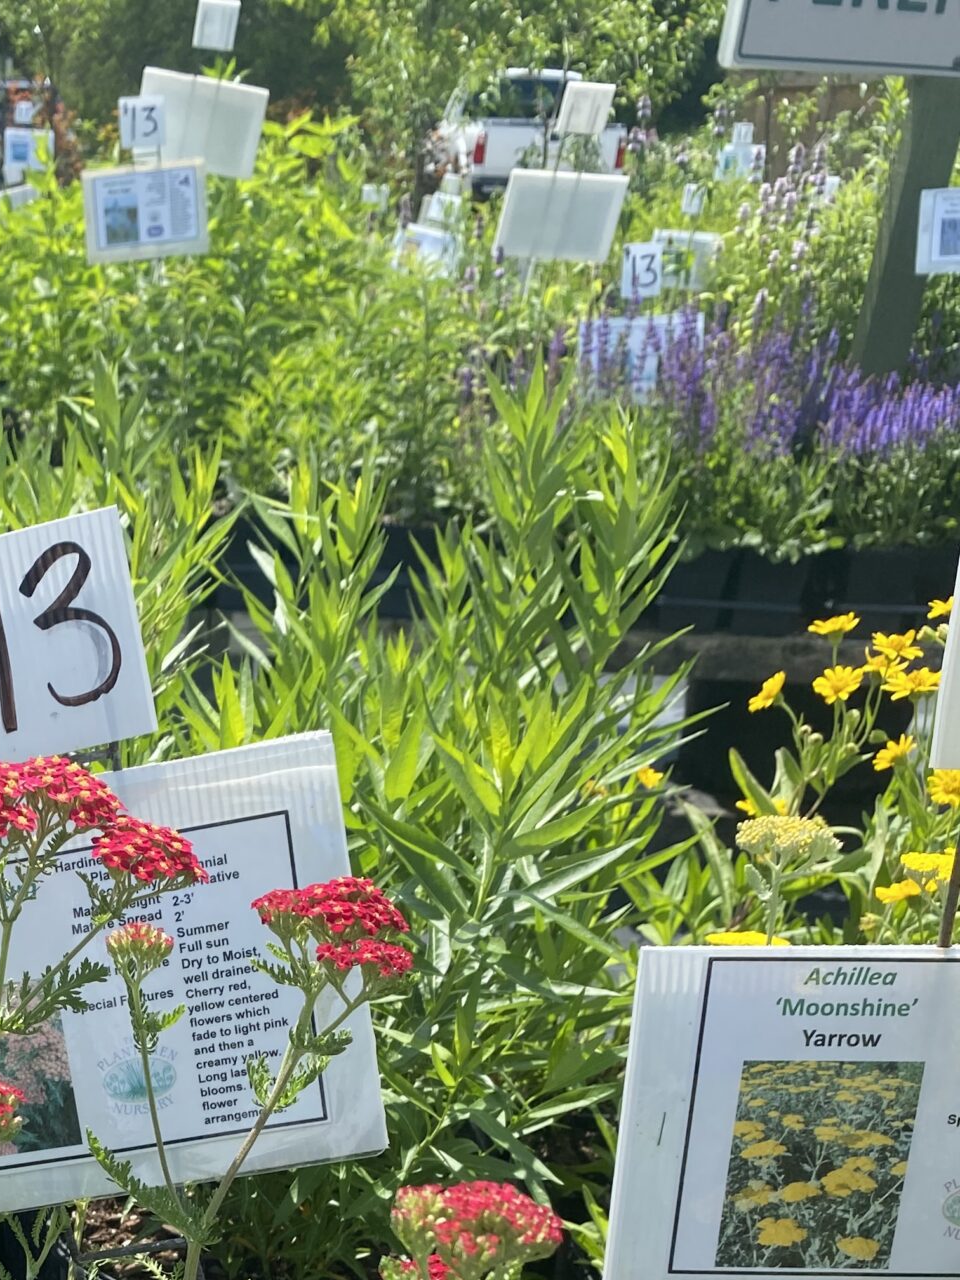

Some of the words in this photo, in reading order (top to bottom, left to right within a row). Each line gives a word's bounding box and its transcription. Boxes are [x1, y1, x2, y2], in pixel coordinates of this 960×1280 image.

[55, 857, 103, 873] Hardine
[126, 895, 161, 910] eight
[71, 920, 115, 935] Matre
[176, 921, 230, 938] Summer
[179, 940, 203, 953] Full
[206, 938, 229, 949] sun
[181, 957, 203, 970] Dry
[207, 955, 220, 965] to
[223, 946, 261, 962] Moist,
[183, 971, 209, 985] well
[803, 966, 898, 986] Achillea
[120, 989, 174, 1007] Ftures
[185, 986, 225, 999] Cherry
[228, 979, 251, 992] red,
[187, 1000, 225, 1016] yellow
[228, 988, 279, 1007] centered
[189, 1013, 233, 1028] flowers
[235, 1006, 270, 1020] which
[192, 1029, 217, 1042] fade
[220, 1028, 232, 1037] to
[234, 1022, 261, 1036] light
[263, 1017, 289, 1032] pink
[194, 1044, 216, 1056] and
[218, 1039, 244, 1052] then
[247, 1038, 254, 1047] a
[802, 1029, 882, 1048] Yarrow
[196, 1055, 238, 1070] creamy
[198, 1071, 228, 1084] Long
[200, 1083, 247, 1097] blooms.
[113, 1094, 175, 1116] NURSRY
[202, 1098, 238, 1111] flower
